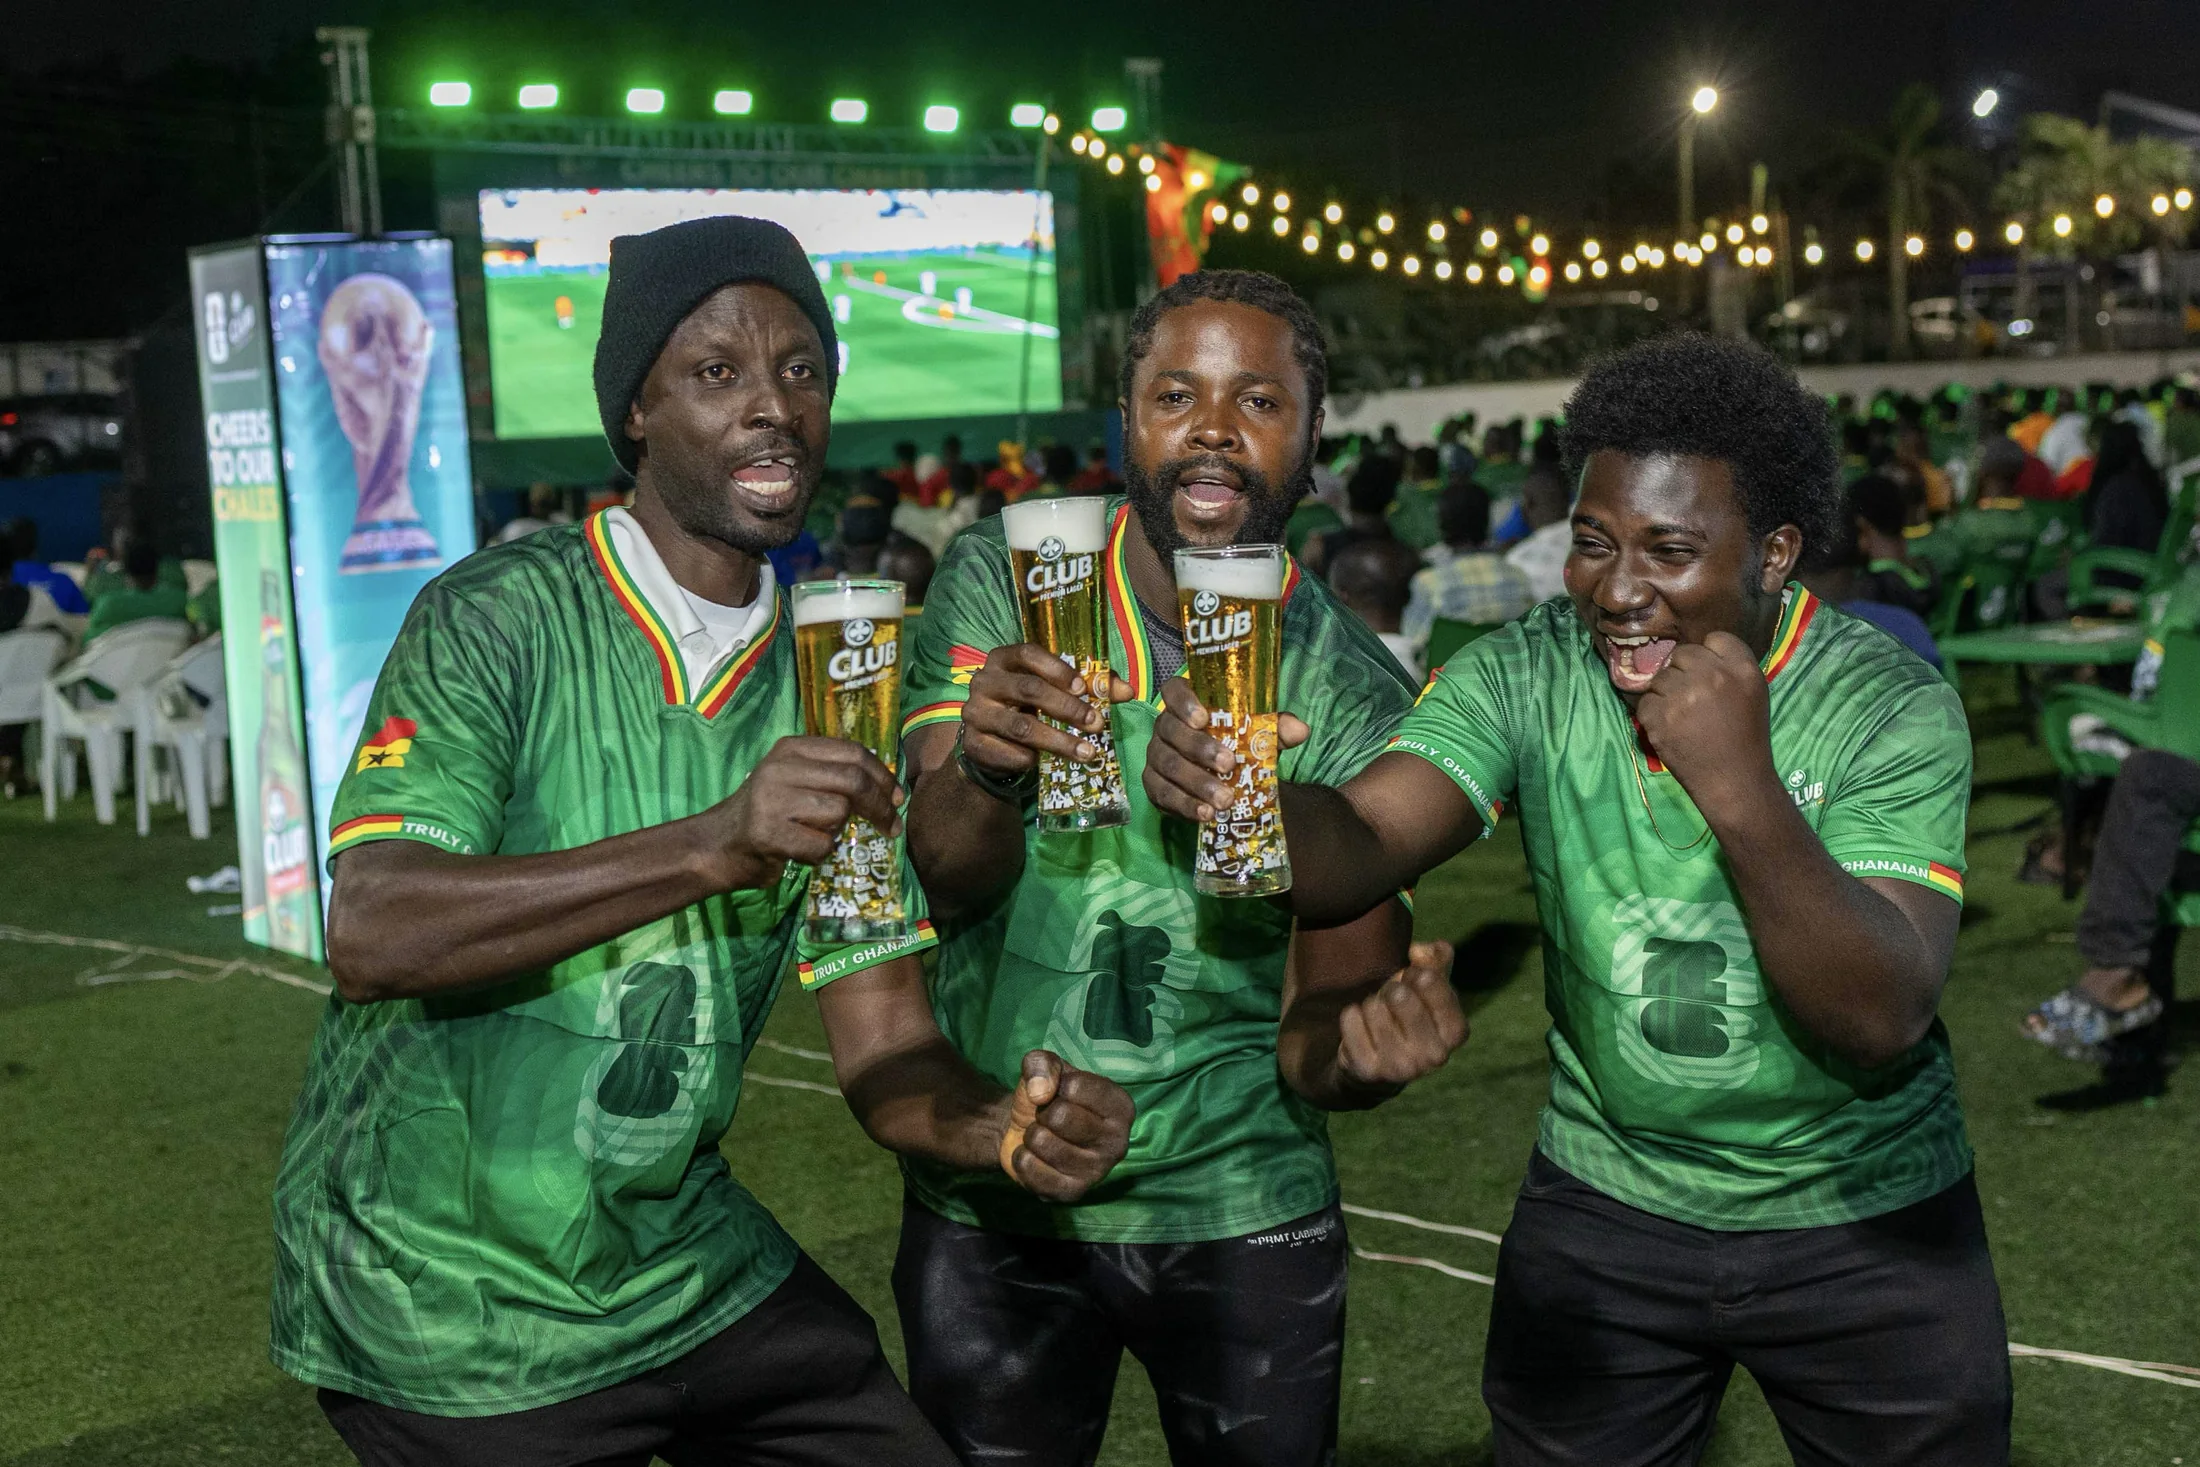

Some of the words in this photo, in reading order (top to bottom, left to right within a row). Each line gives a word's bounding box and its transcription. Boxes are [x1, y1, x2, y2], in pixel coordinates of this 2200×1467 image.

[208, 409, 271, 447] CHEERS
[210, 449, 235, 486] TO
[236, 447, 275, 485] OUR
[1026, 554, 1093, 593] CLUB
[1186, 610, 1252, 646] CLUB
[828, 640, 897, 681] CLUB
[1395, 740, 1440, 756] TRULY
[1788, 781, 1824, 806] LUB
[404, 822, 461, 847] TRULY
[814, 958, 847, 981] TRULY
[852, 932, 922, 964] GHANAIAN
